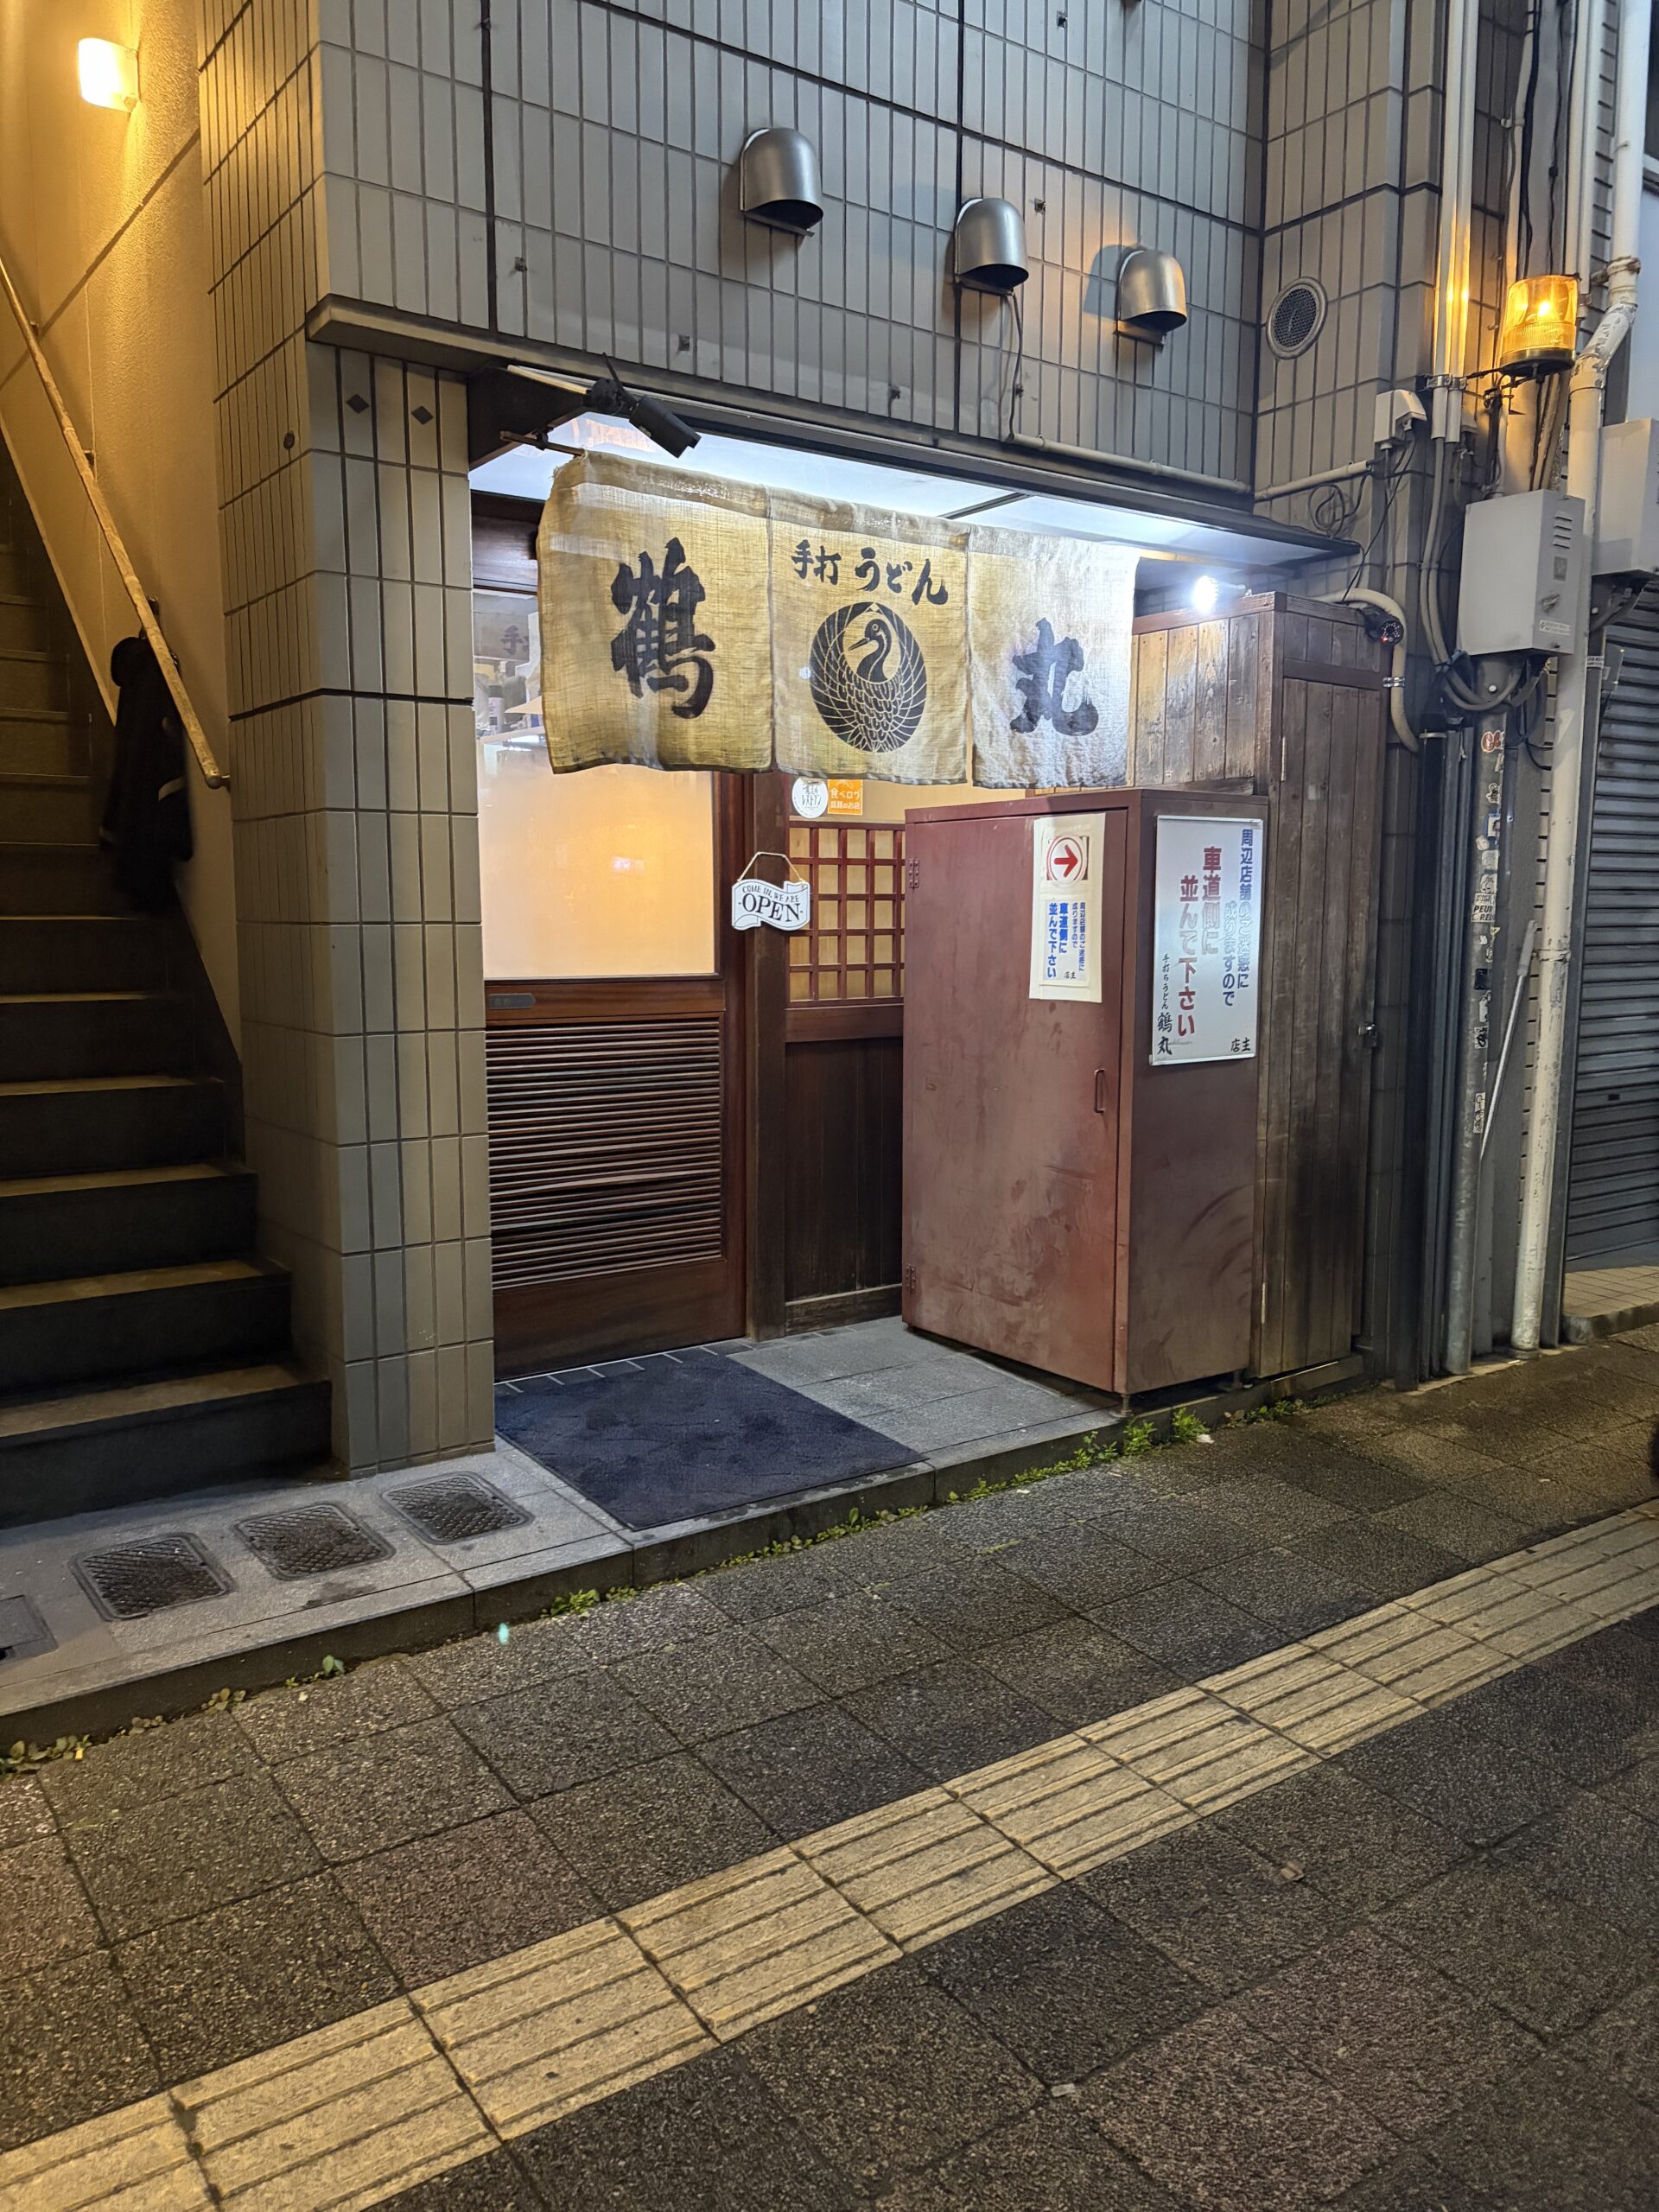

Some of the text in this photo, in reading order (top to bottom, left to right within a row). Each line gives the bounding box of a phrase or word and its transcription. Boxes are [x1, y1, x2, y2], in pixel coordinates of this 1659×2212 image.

[791, 539, 949, 606] 手打うどん
[611, 537, 1098, 736] 鶴 丸
[742, 885, 761, 893] COME
[773, 893, 784, 901] WE
[785, 894, 799, 903] ARE
[742, 893, 800, 922] OPEN
[1058, 902, 1069, 954] 車道側に
[1201, 846, 1222, 956] 車道側に
[1237, 829, 1254, 989] 周辺店舗のご迷惑に
[1047, 902, 1058, 978] 並んで下さい
[1177, 874, 1198, 1037] 並んで下さい
[1223, 900, 1237, 1007] 成りますので
[1230, 1037, 1251, 1052] 店主
